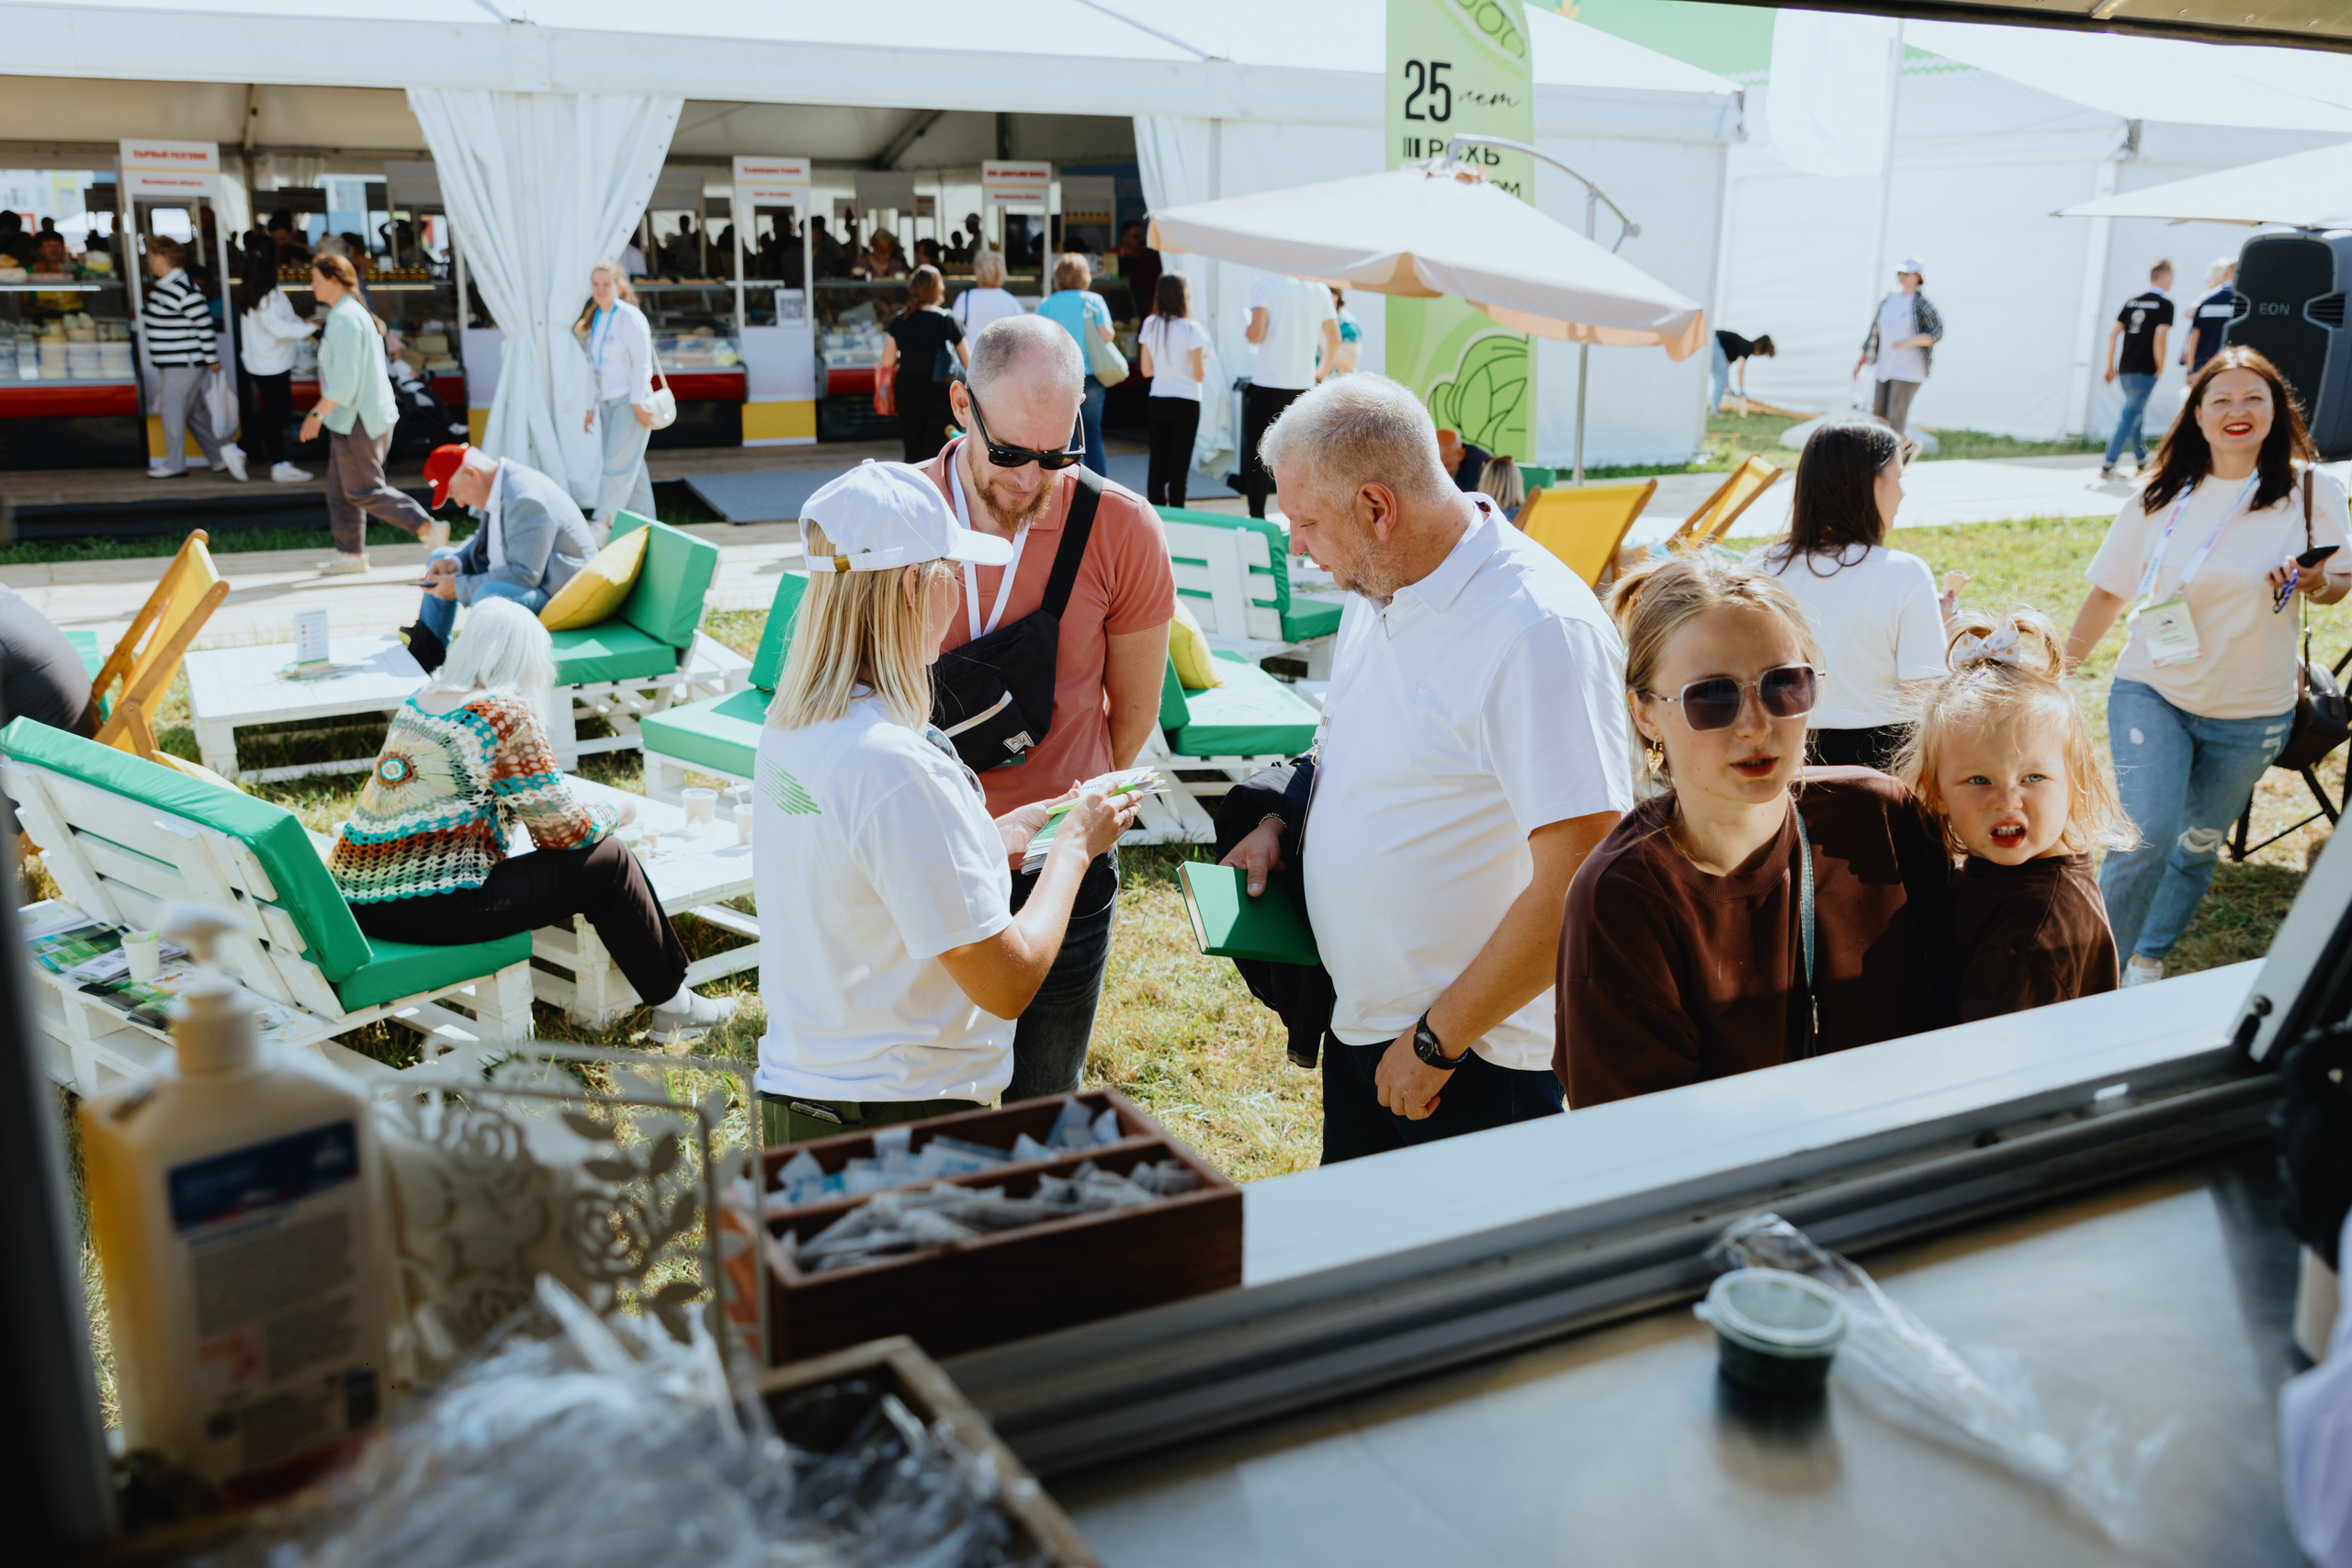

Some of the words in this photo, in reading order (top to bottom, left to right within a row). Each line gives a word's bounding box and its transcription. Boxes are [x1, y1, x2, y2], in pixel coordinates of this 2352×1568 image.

[1405, 60, 1452, 122] 25
[1458, 90, 1521, 107] лет
[1429, 140, 1500, 165] РХБ
[2258, 302, 2290, 316] EON
